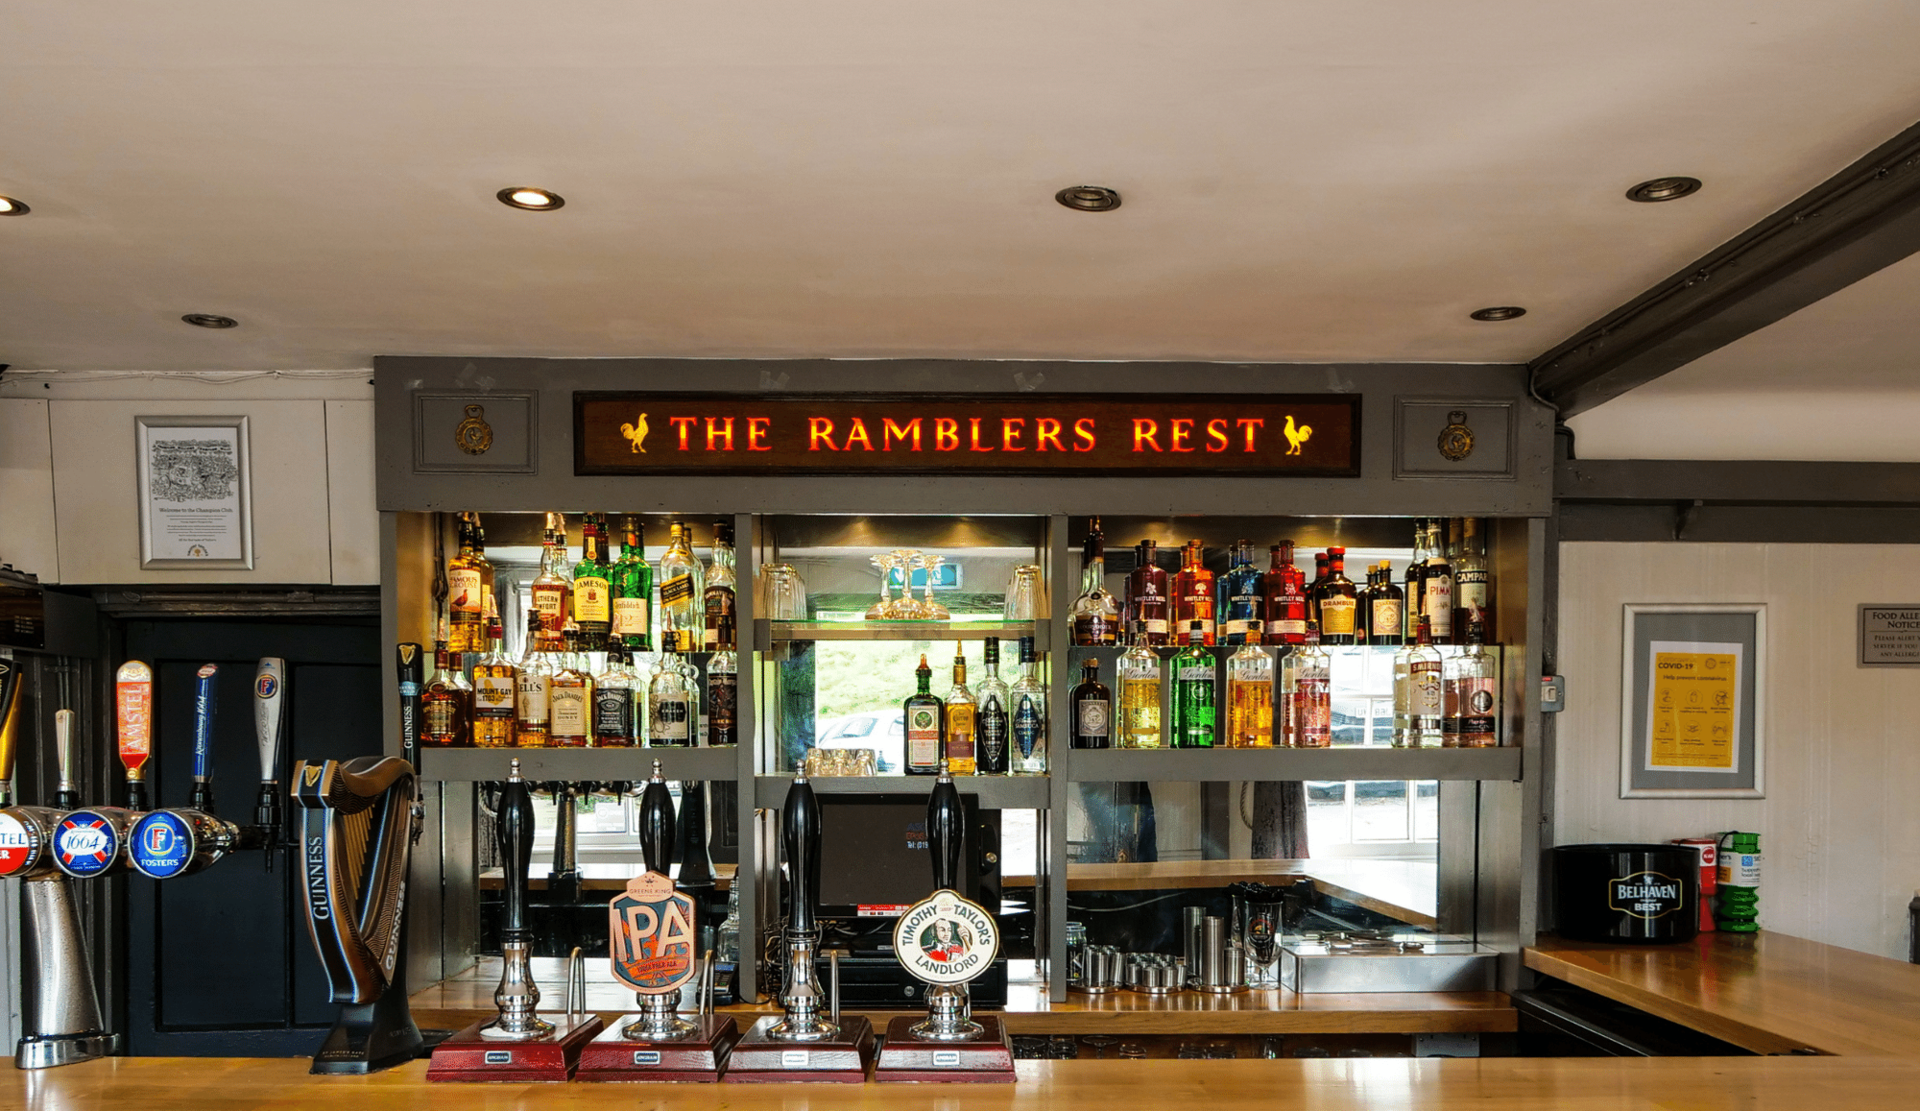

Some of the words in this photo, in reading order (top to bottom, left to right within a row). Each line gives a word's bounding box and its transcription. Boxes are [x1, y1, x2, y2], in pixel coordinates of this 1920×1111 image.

[670, 416, 773, 452] THE
[807, 416, 1096, 453] RAMBLERS
[1131, 417, 1264, 453] REST
[1456, 573, 1487, 582] CAMPAR
[576, 580, 608, 592] JAMESON
[1430, 586, 1451, 596] PIMM
[1872, 612, 1898, 620] FOOD
[1900, 612, 1920, 620] ALLE
[1888, 620, 1920, 629] NOTICE
[1412, 661, 1441, 672] SMIRNO
[1658, 662, 1694, 670] COVID-19
[261, 678, 271, 695] F
[500, 688, 512, 696] GAY
[519, 682, 542, 692] ELL'S
[125, 684, 143, 750] AMSTEL
[403, 705, 414, 749] GUINNESS
[0, 833, 26, 845] TEL
[66, 834, 101, 850] 1664
[152, 828, 167, 850] F
[141, 858, 179, 867] FOSTER'S
[308, 836, 330, 920] GUINNESS
[1617, 884, 1676, 900] BELHAVEN
[1634, 902, 1662, 911] BEST
[385, 880, 405, 971] GUINNESS
[612, 900, 690, 963] IPA
[902, 904, 937, 946] TIMOTHY
[954, 904, 992, 946] TAYLOR'S
[915, 953, 979, 975] LANDLORD
